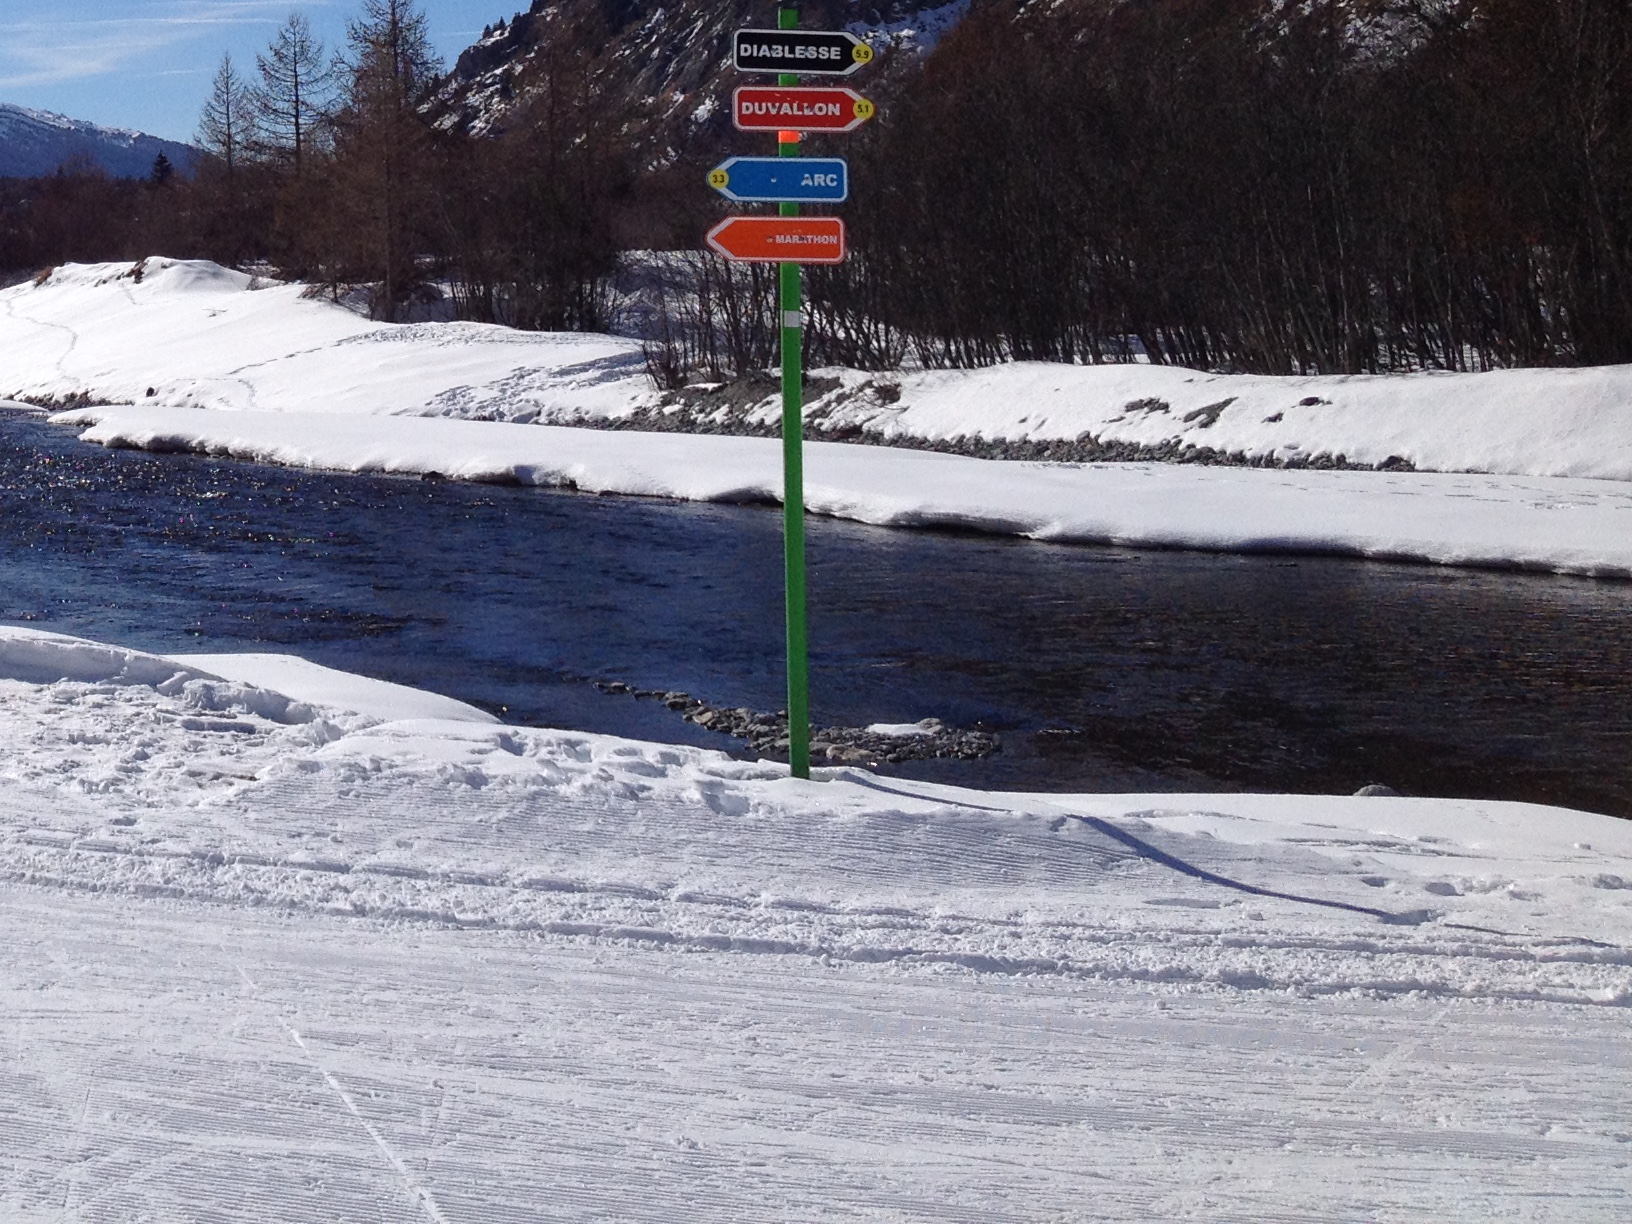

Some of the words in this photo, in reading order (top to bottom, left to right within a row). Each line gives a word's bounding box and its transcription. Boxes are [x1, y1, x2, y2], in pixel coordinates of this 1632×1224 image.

[740, 43, 841, 59] DIABLESSE
[741, 102, 841, 116] DUVALLON
[800, 173, 838, 187] ARC
